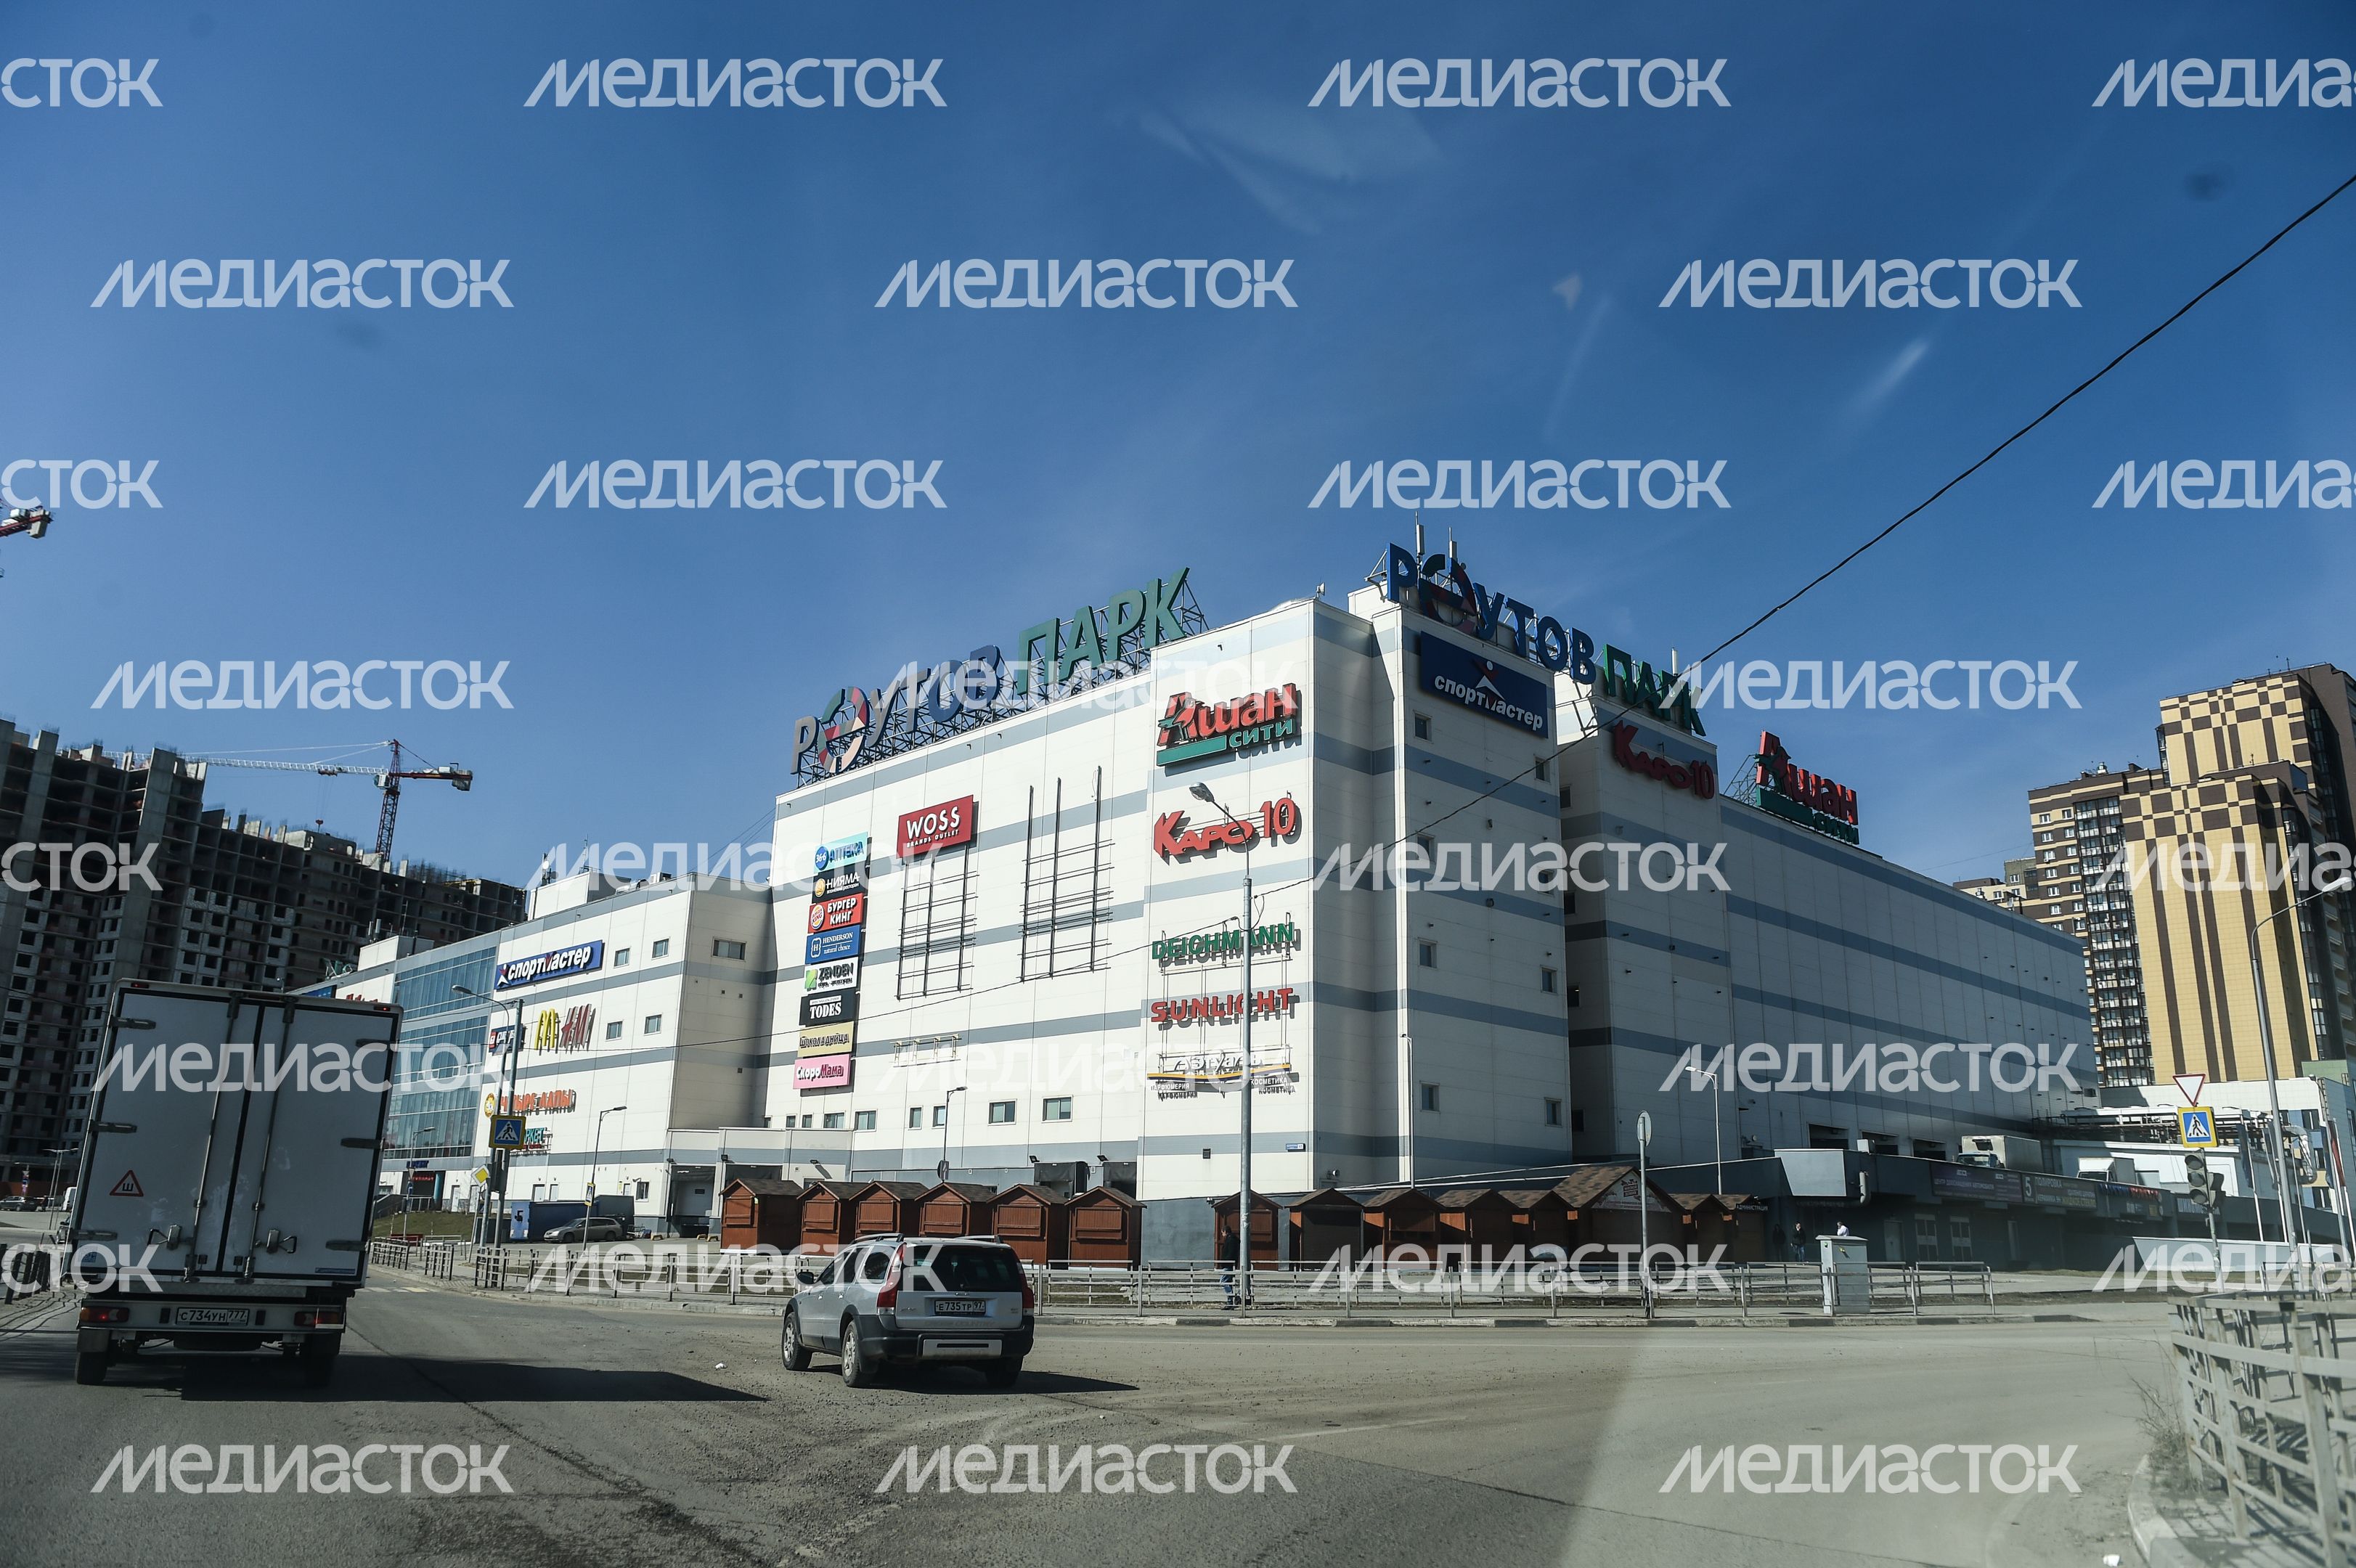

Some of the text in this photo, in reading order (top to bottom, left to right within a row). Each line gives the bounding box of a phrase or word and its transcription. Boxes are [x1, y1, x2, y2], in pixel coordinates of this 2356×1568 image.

[1017, 567, 1190, 695] ПАРК
[1690, 760, 1714, 799] 10
[906, 807, 960, 839] WOSS
[1259, 798, 1295, 838] 10
[906, 829, 959, 848] BRANDS OUTLET
[826, 872, 860, 889] НИЯМА
[827, 898, 856, 913] БУРГЕР
[830, 911, 852, 925] КИНГ
[823, 932, 853, 944] HENDERSON
[818, 963, 854, 981] ZENDEN
[810, 1002, 841, 1019] TODES
[799, 1033, 849, 1048] ШОКОЛАДНИЦА
[122, 1183, 134, 1191] Ш
[2024, 1177, 2032, 1197] 5
